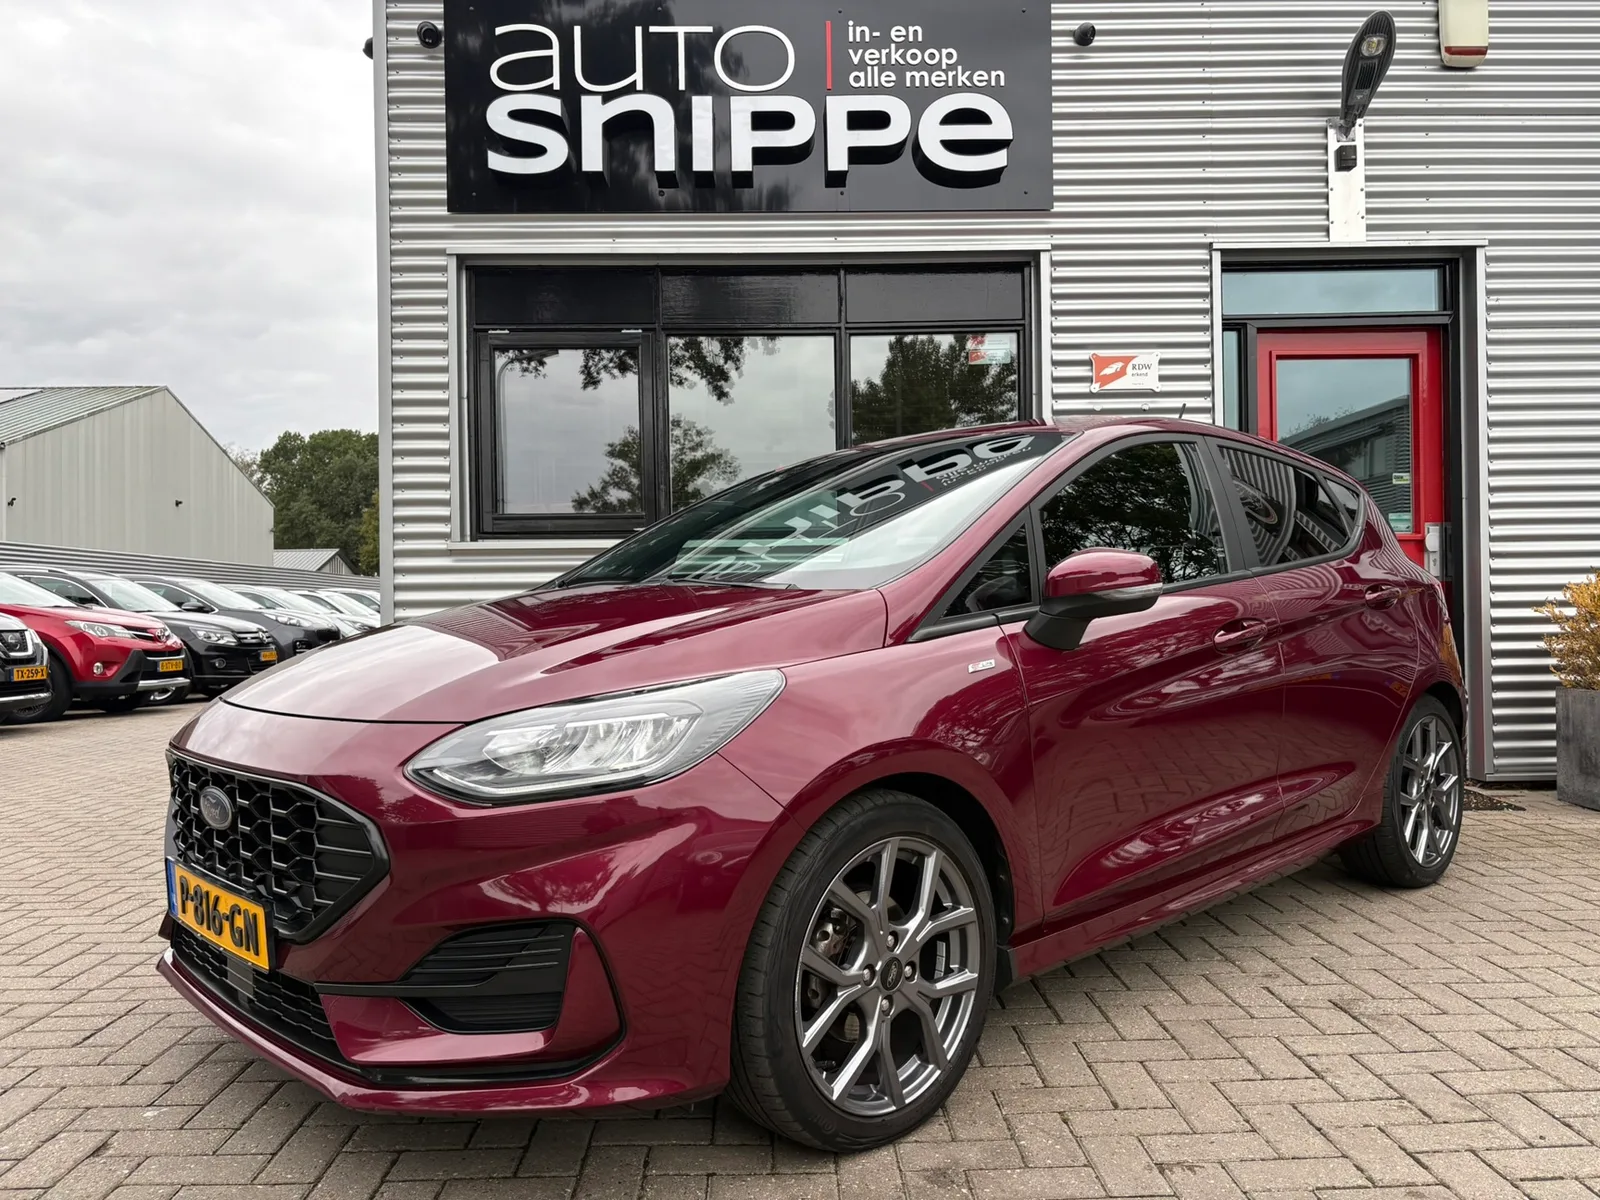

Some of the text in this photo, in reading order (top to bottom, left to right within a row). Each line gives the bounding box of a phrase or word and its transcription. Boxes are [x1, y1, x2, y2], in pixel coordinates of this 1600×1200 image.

[847, 20, 923, 44] in- en
[847, 44, 958, 69] verkoop
[848, 65, 1005, 88] alle merken
[1131, 363, 1153, 371] RDW
[16, 668, 45, 680] TX-259-X
[179, 874, 260, 957] P-816-GN
